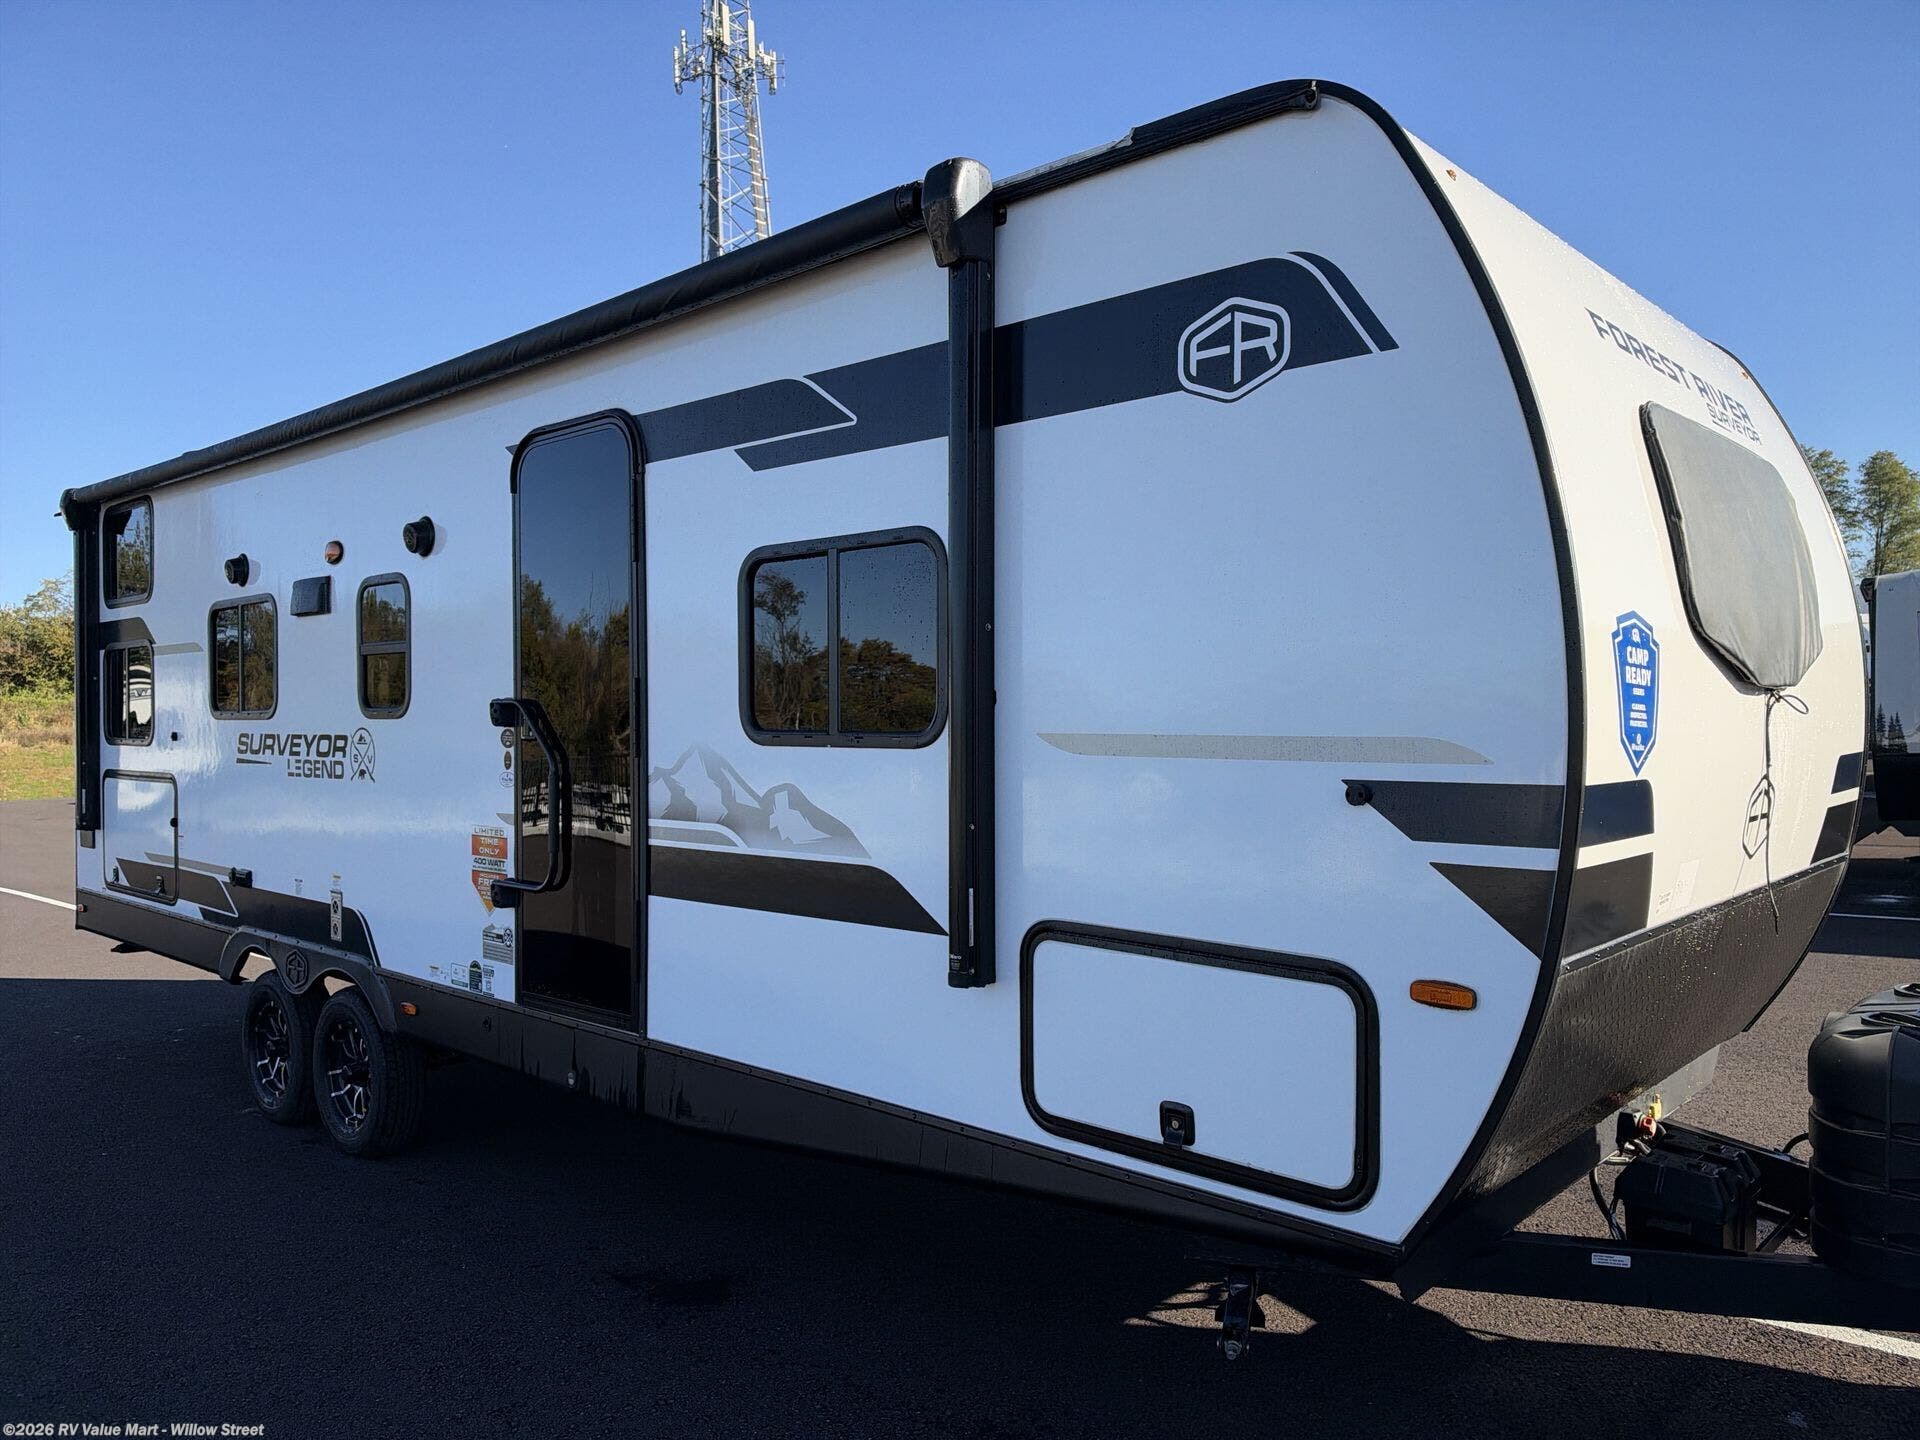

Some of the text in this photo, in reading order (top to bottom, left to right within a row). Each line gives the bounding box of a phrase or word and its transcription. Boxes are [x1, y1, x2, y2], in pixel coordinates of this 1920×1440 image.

[1190, 311, 1278, 385] FR
[1584, 307, 1753, 427] FOREST RIVER
[1706, 402, 1762, 445] SURVEYOR
[1626, 645, 1649, 667] CAMP
[1625, 666, 1652, 687] READY
[237, 732, 348, 758] SURVEYOR
[287, 758, 344, 780] LEGEND
[474, 827, 505, 837] LIMITED
[480, 837, 499, 846] TIME
[479, 846, 500, 856] ONLY
[473, 857, 505, 868] 400 WATT
